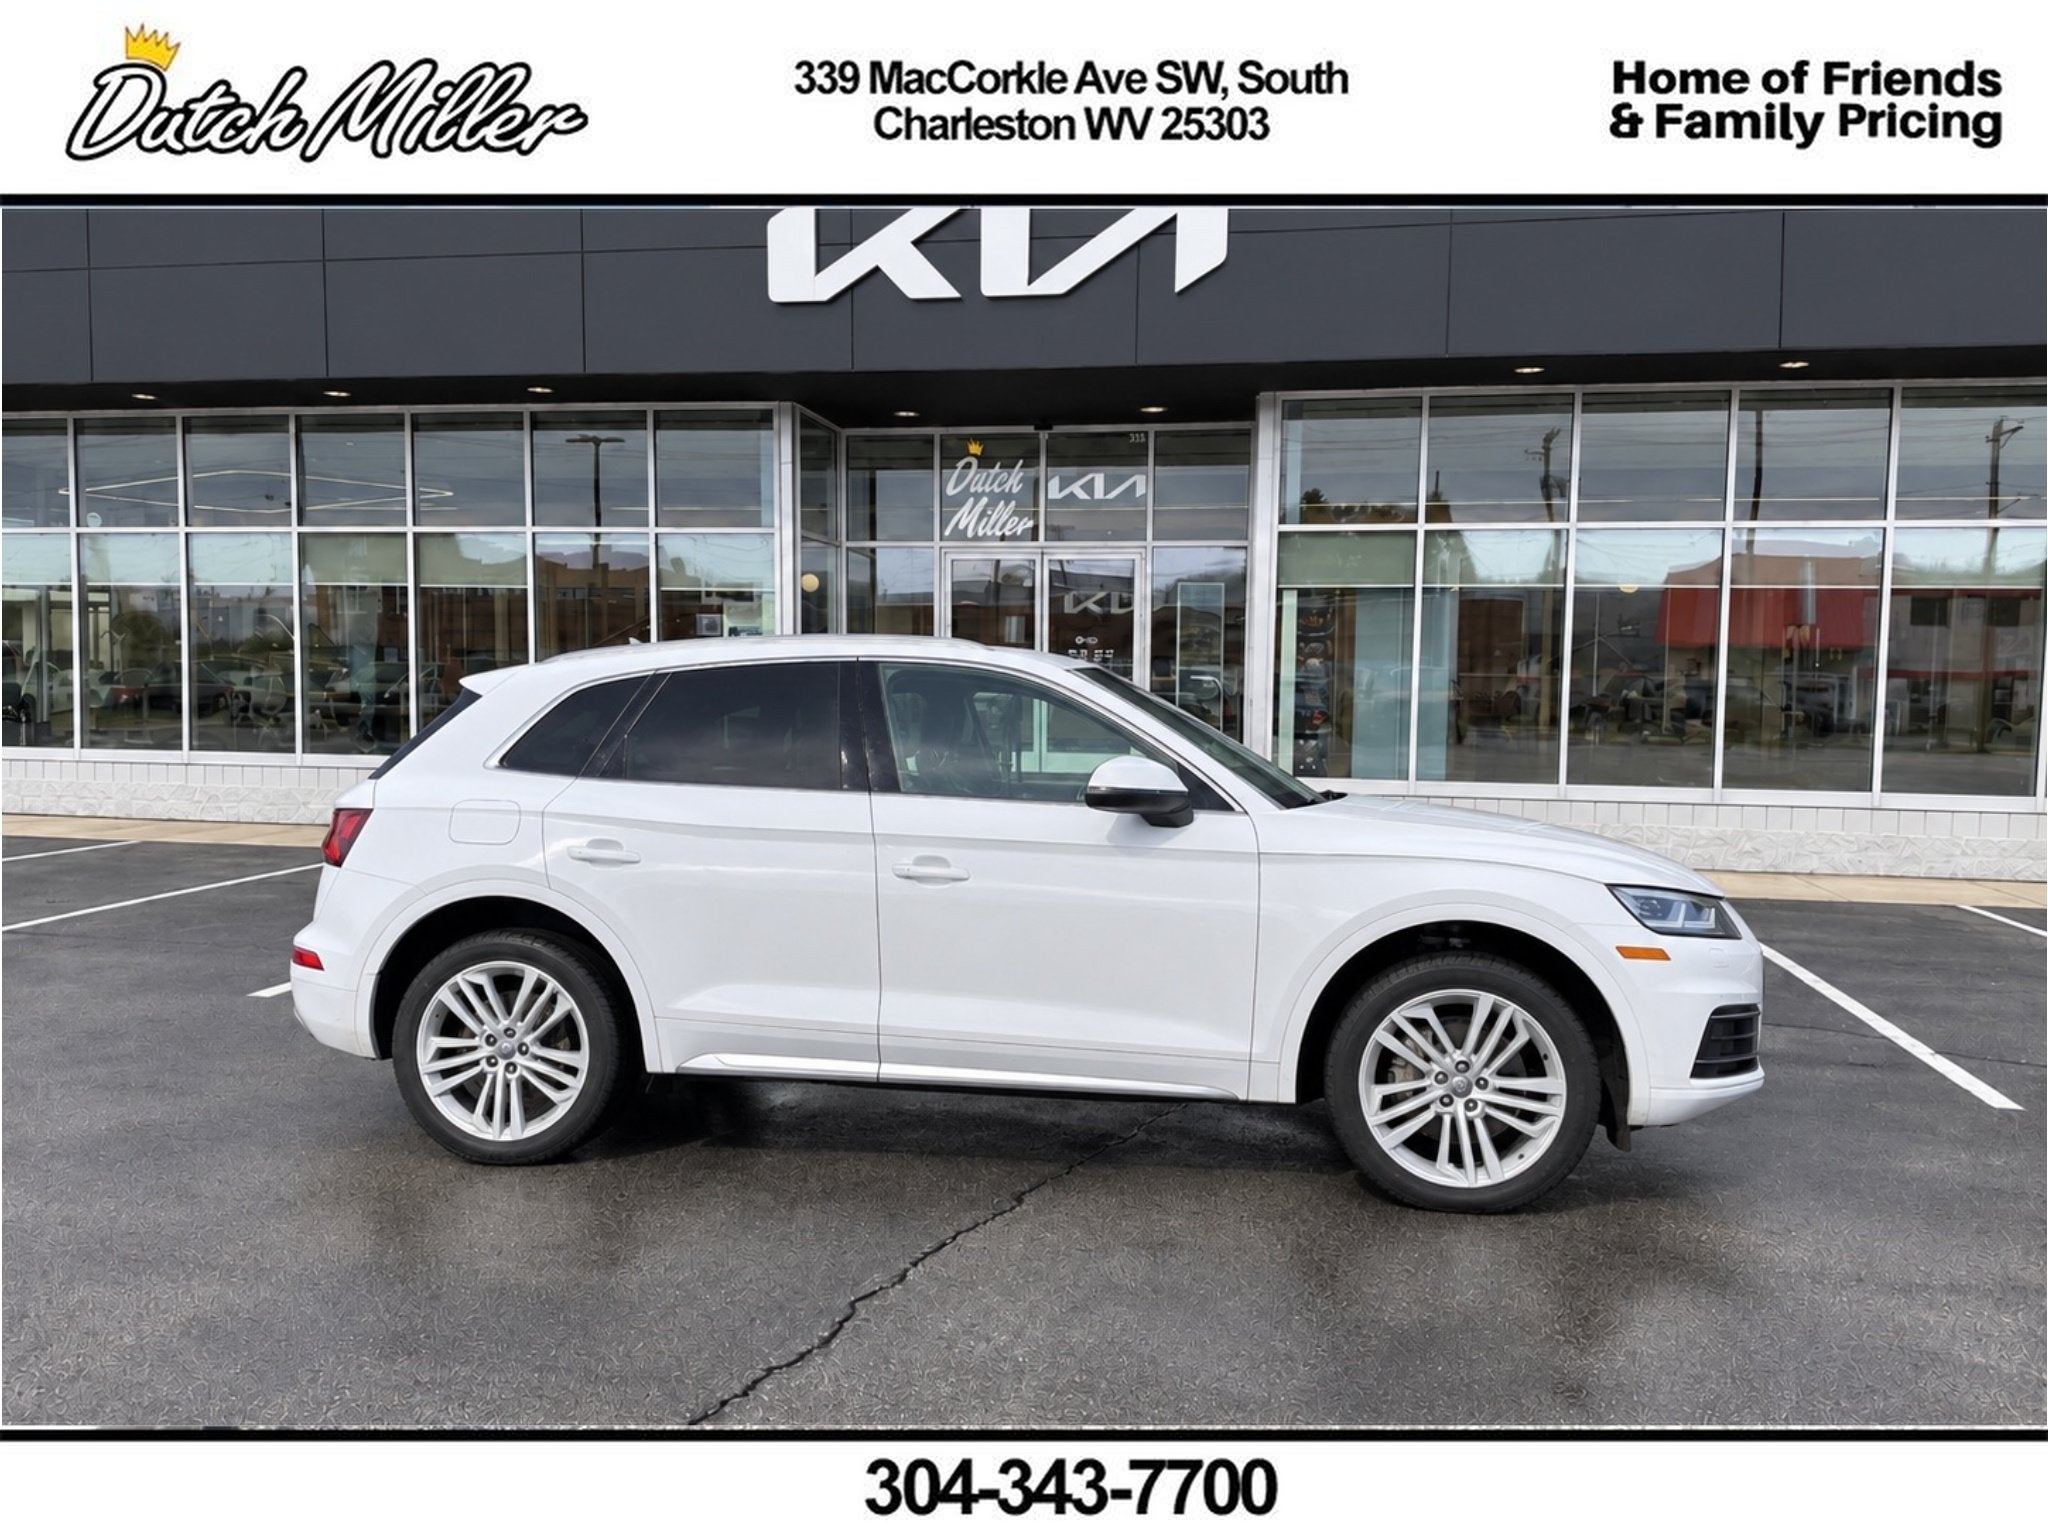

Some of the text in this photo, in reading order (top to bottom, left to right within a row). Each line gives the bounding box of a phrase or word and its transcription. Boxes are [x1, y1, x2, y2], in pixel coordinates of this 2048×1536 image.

[946, 456, 1025, 497] Dutch
[1047, 472, 1147, 500] KIA
[944, 497, 1034, 538] Miller
